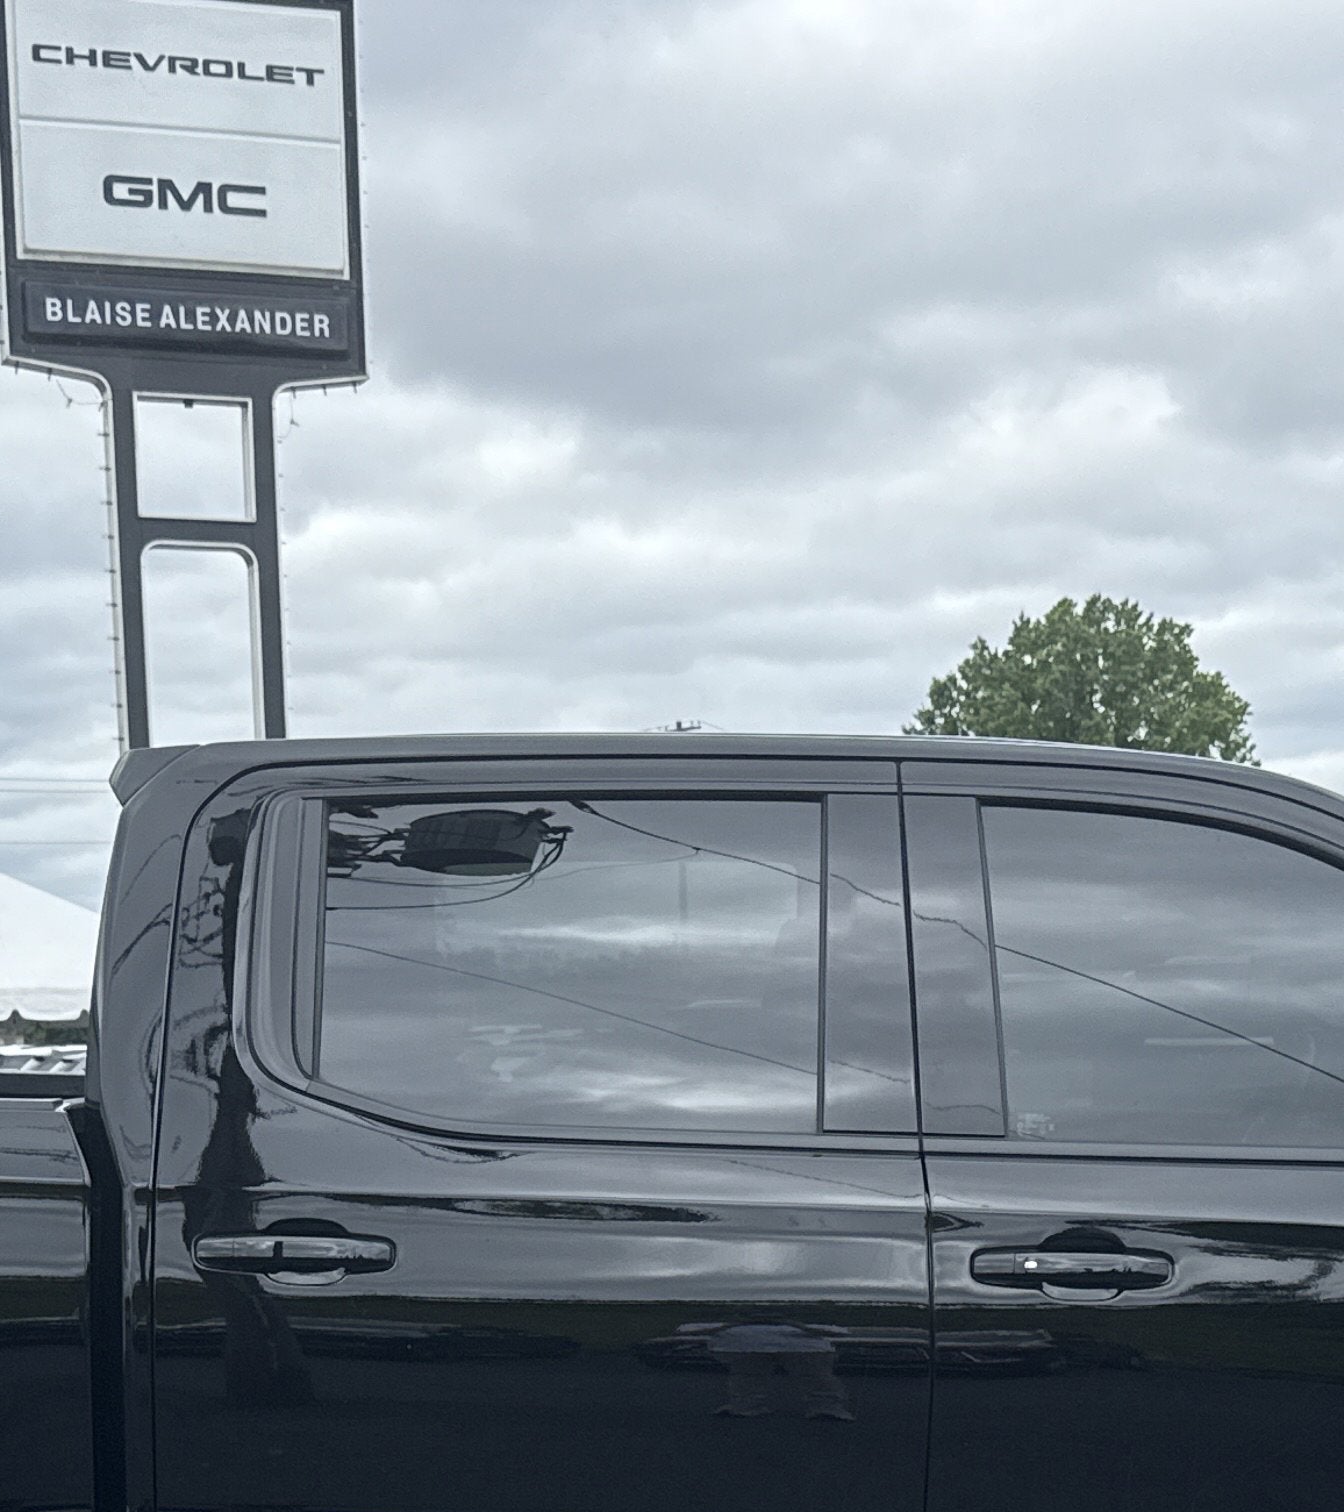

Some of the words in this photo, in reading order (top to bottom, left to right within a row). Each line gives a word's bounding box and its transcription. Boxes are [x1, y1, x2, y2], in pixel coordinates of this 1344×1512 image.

[31, 43, 325, 87] CHEVROLET
[103, 174, 267, 218] GMC
[45, 297, 152, 328] BLAISE
[159, 304, 331, 338] ALEXANDER
